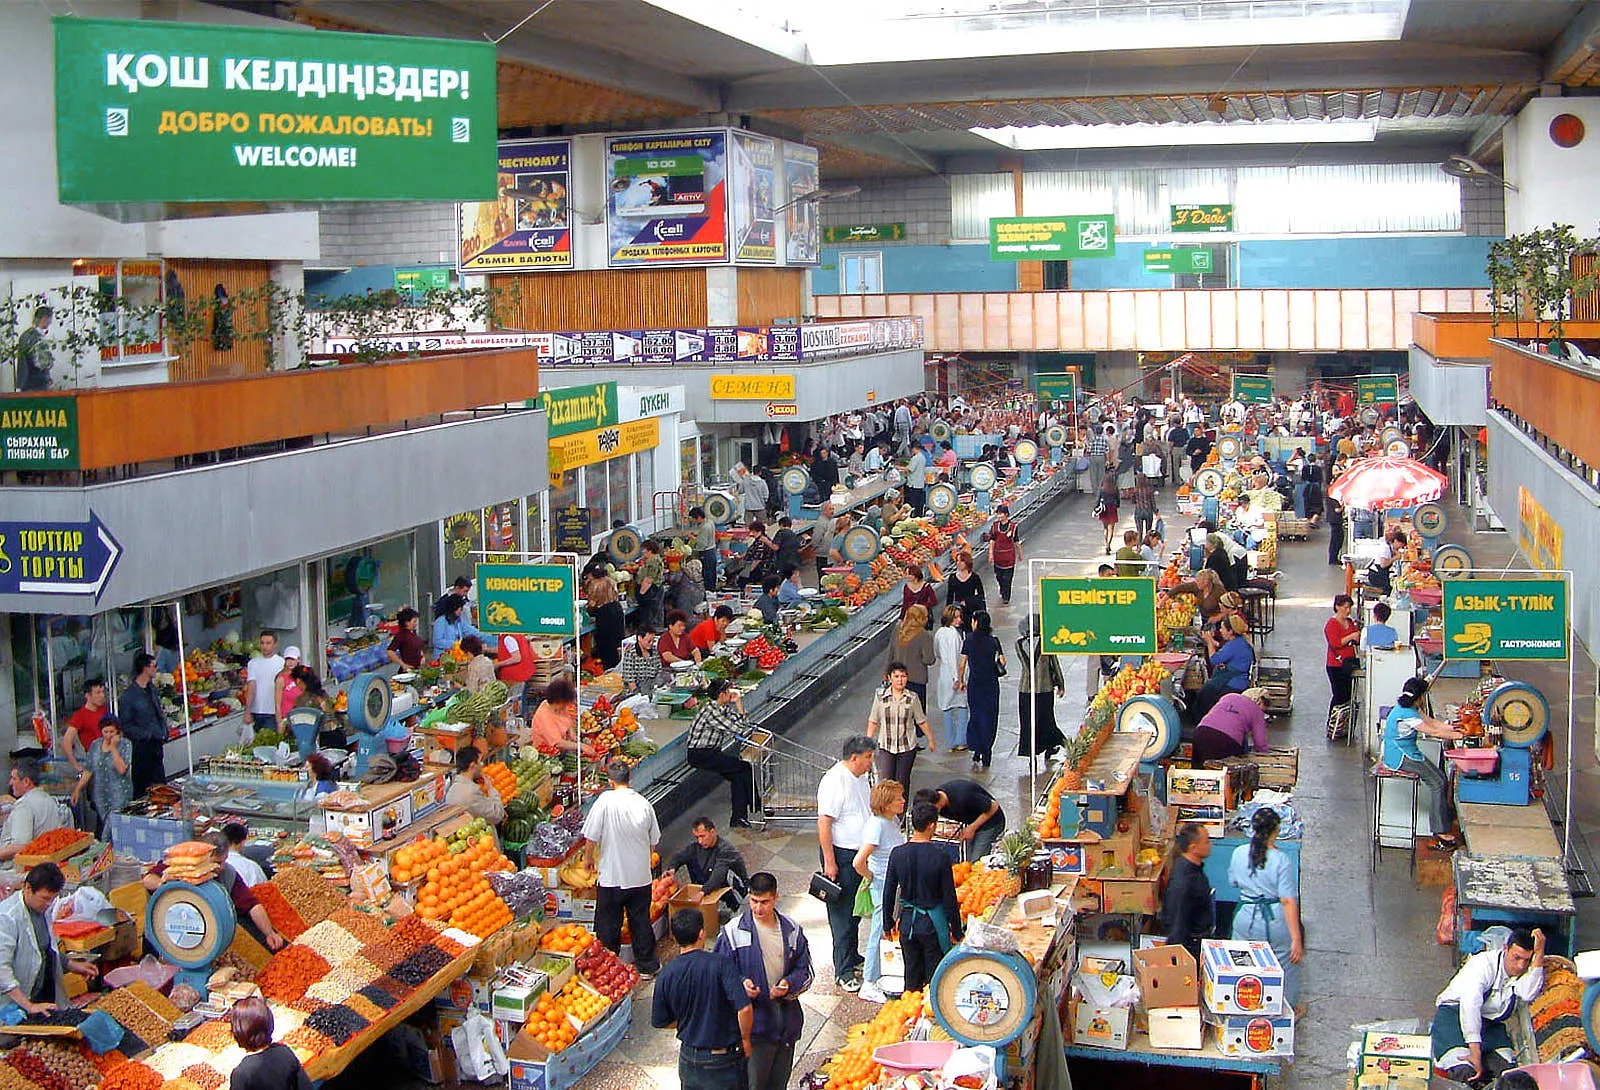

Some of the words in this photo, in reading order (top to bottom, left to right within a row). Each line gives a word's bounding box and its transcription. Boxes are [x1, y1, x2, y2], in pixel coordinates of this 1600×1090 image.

[106, 53, 209, 94] ҚОШ
[224, 58, 470, 101] КЕЛДІҢІЗДЕР!
[158, 110, 250, 135] ДОБРО
[258, 113, 433, 137] ПОЖАЛОВАТЬ!
[694, 138, 711, 146] САТУ
[235, 145, 357, 168] WELCOME!
[520, 255, 568, 263] ВАЛЮТЫ
[803, 330, 834, 348] DOSTAR
[711, 377, 793, 395] СЕМЕНА
[640, 392, 670, 417] ДҮКЕНІ
[6, 436, 58, 448] СЫРАХАНА
[7, 447, 45, 460] ПИВНОЙ
[50, 448, 70, 460] БАР
[19, 530, 83, 552] ТОРТТАР
[20, 556, 84, 579] ТОРТЫ
[485, 577, 564, 593] КӨКӨНІСТЕР
[1057, 589, 1137, 605] ЖЕМІСТЕР
[1453, 594, 1555, 613] АЗЫҚ-ТҮЛІК
[540, 616, 566, 626] ОВОЩИ
[1109, 635, 1146, 644] ФРУКТЫ
[1500, 639, 1562, 649] ГАСТРОНОМИЯ
